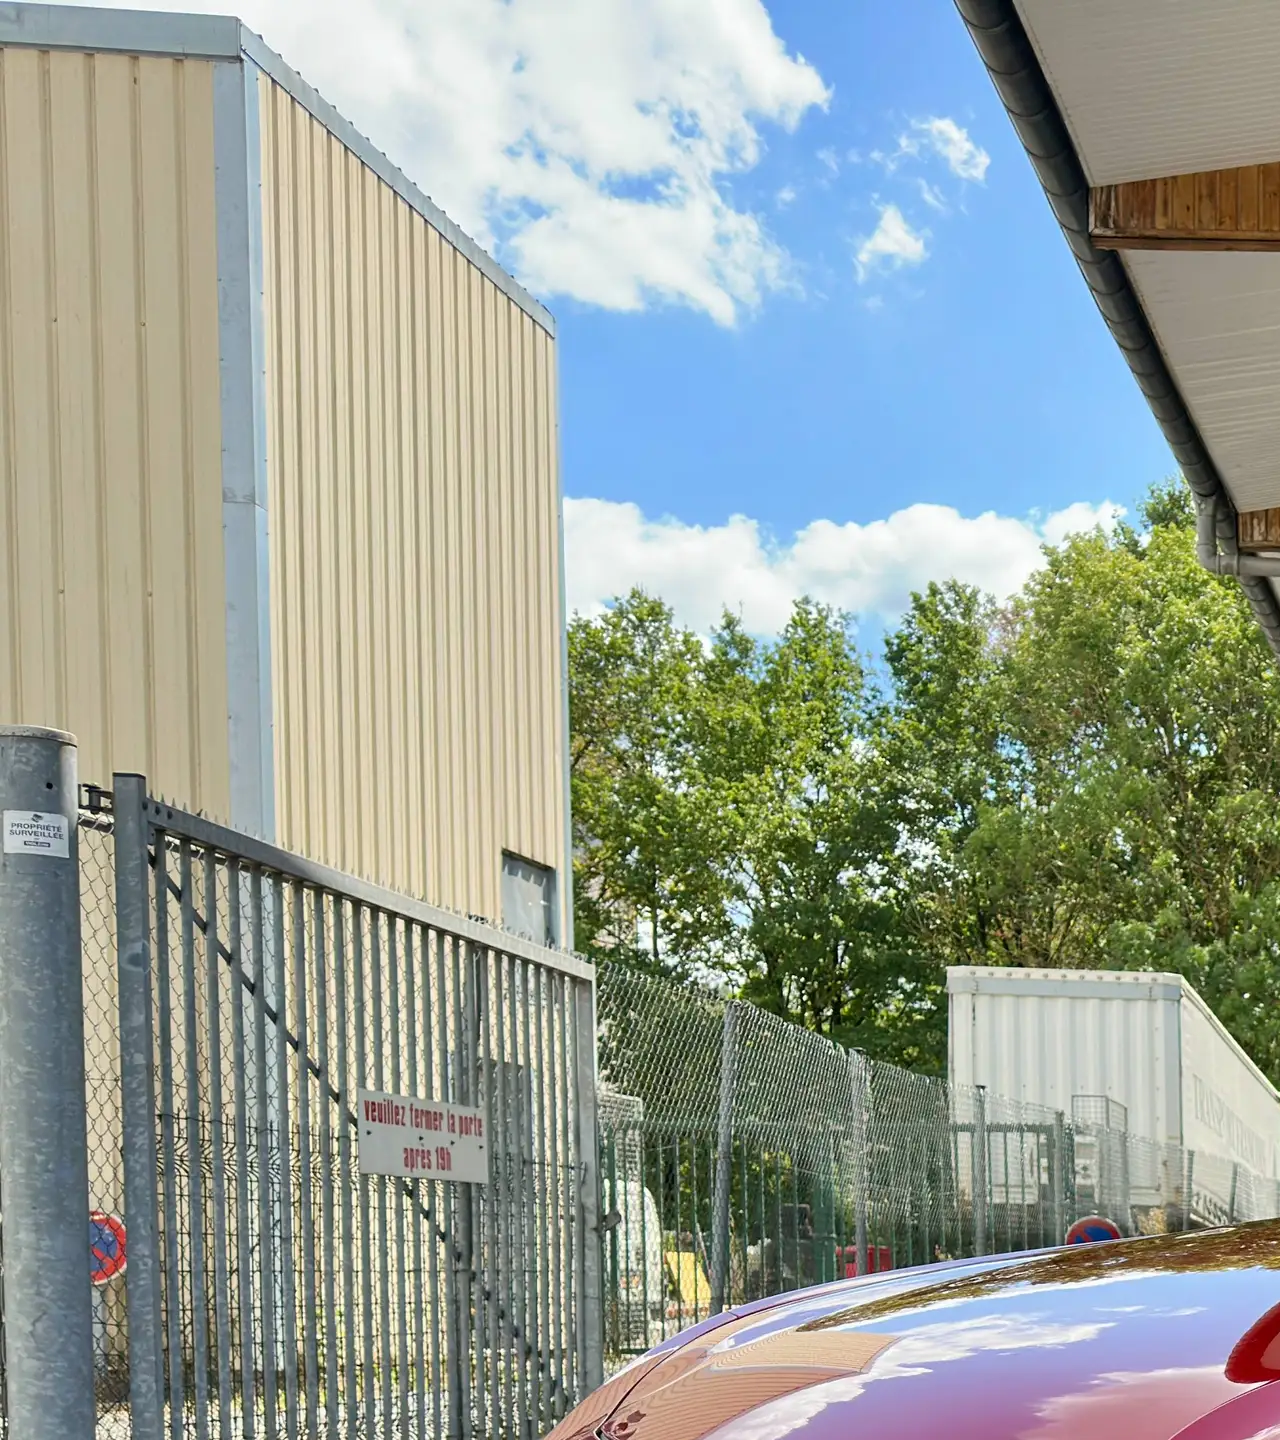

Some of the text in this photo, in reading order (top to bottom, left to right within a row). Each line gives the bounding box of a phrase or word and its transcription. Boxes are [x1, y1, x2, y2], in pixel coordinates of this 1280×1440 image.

[9, 829, 64, 840] SURVEILLÉE
[11, 822, 62, 833] PROPRIÉTÉ
[364, 1098, 483, 1139] veuillez fermer la porte
[403, 1143, 452, 1172] après 19h
